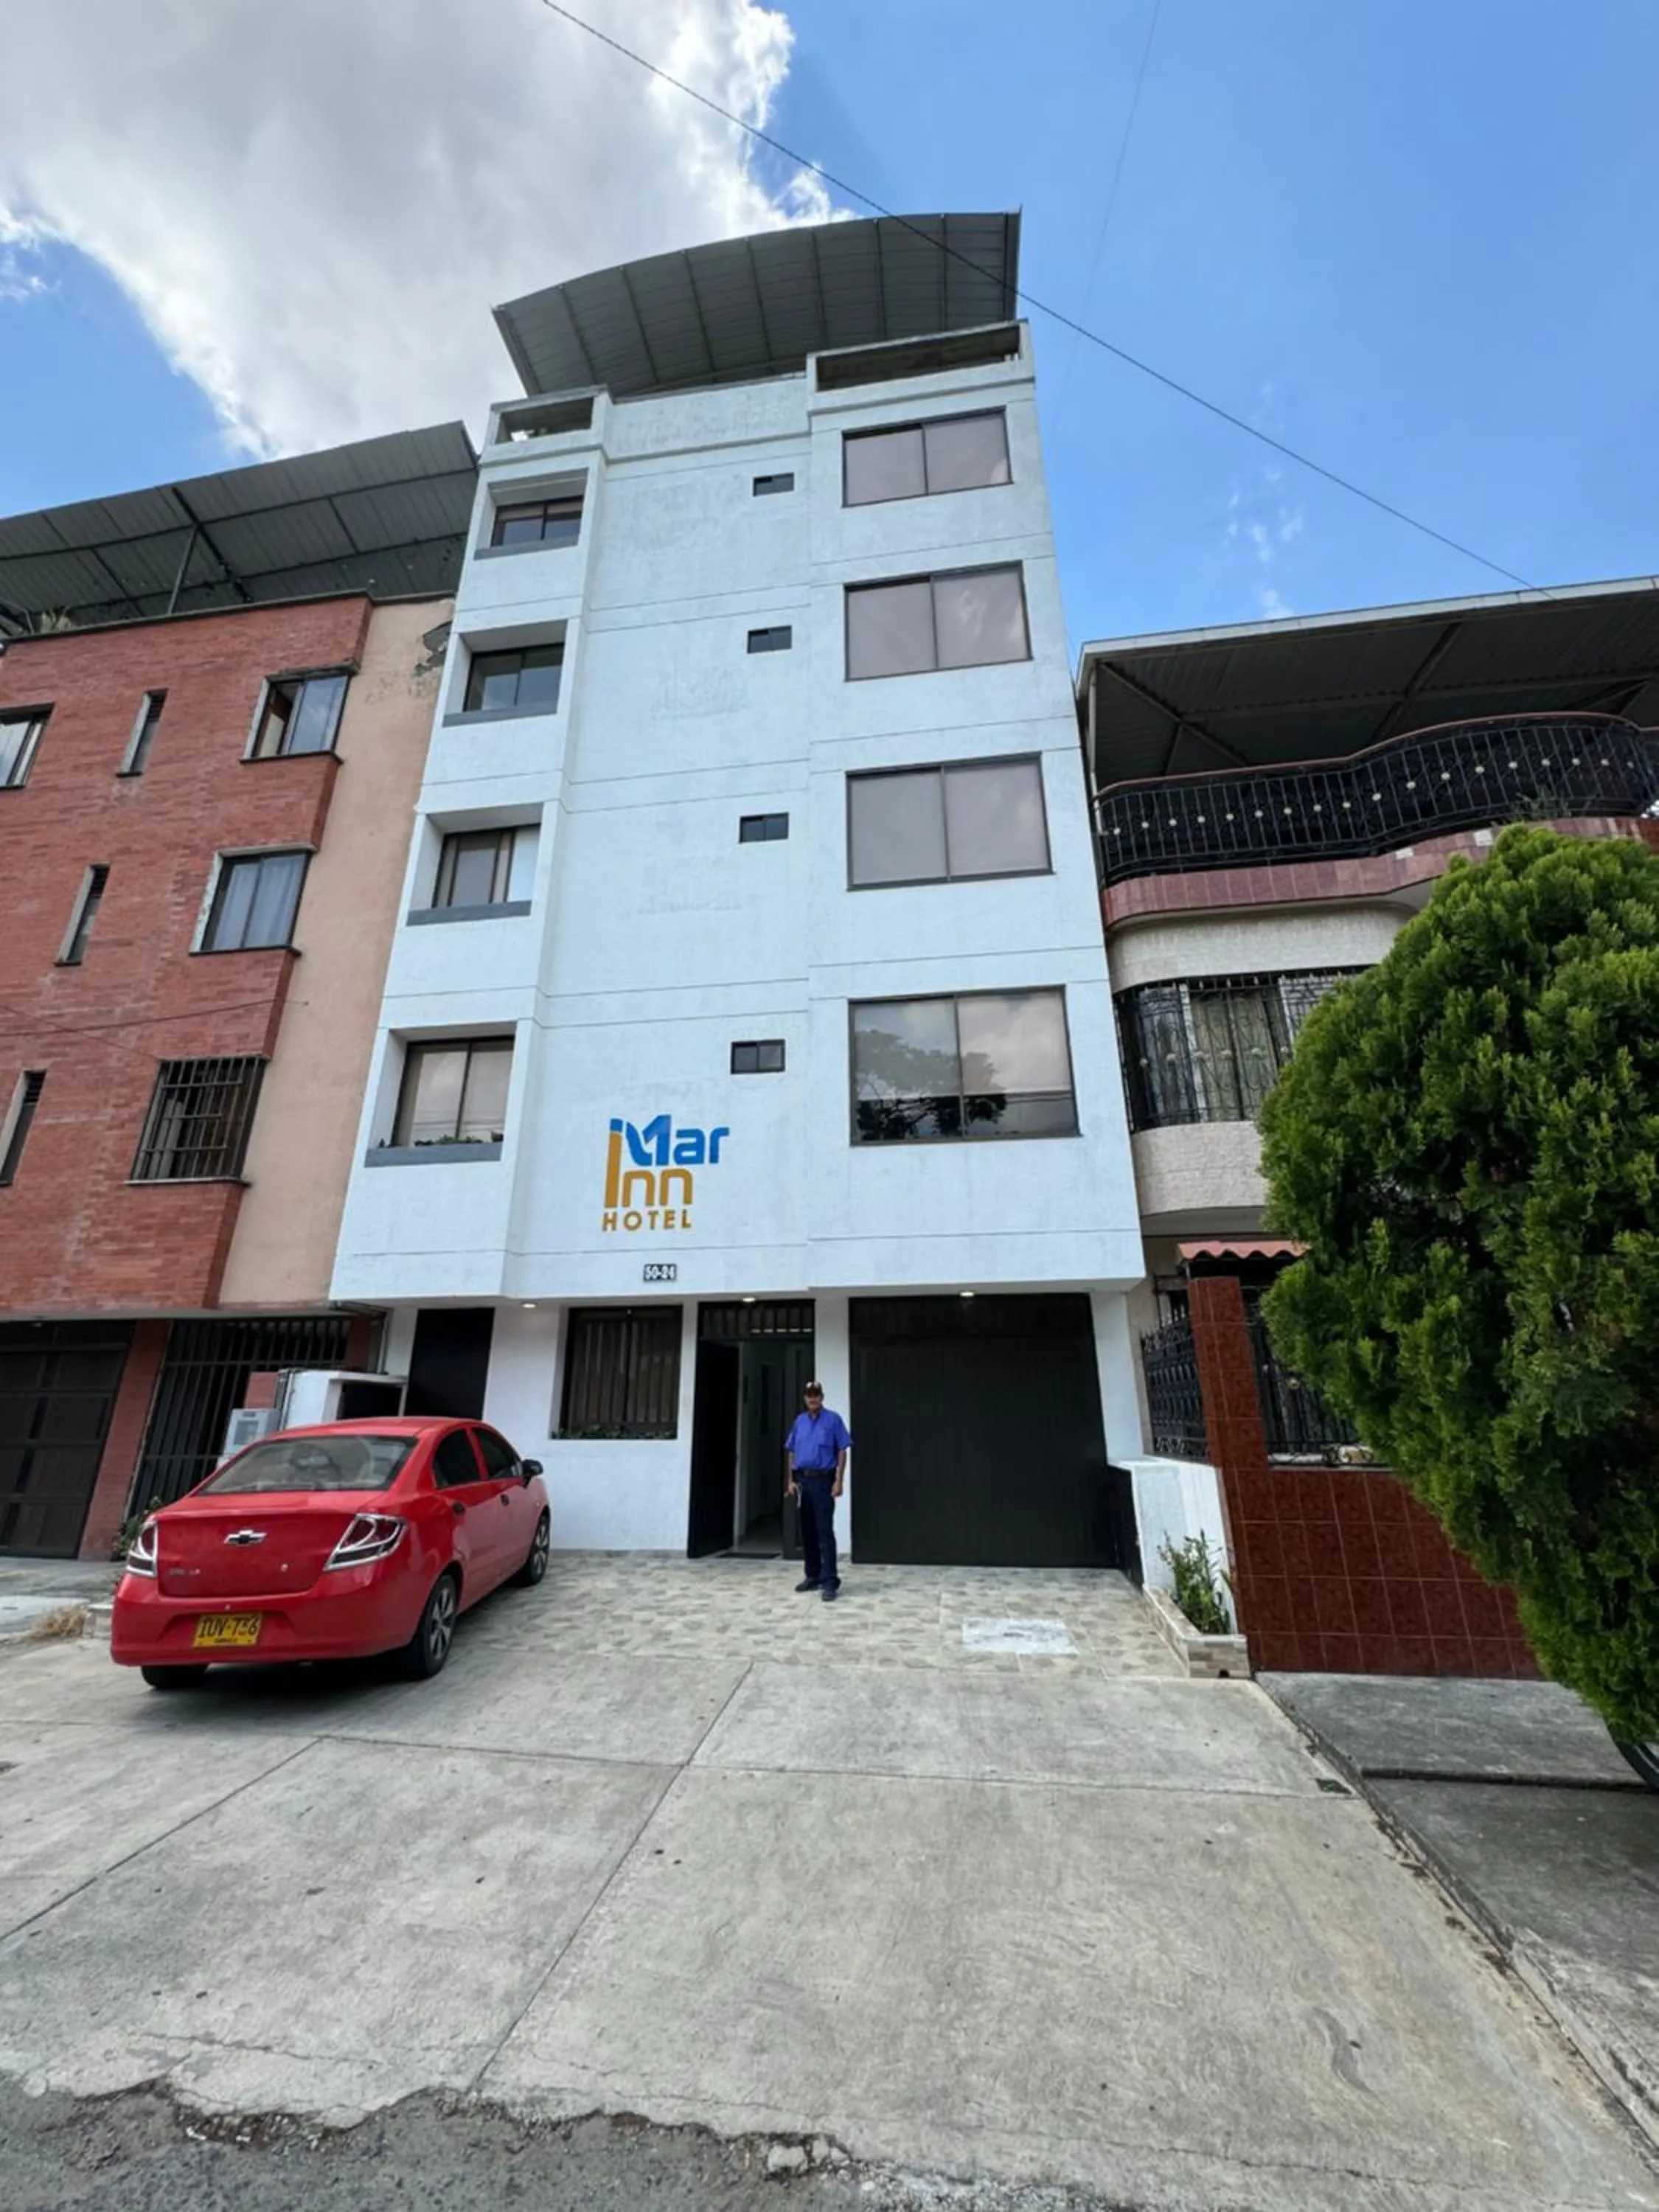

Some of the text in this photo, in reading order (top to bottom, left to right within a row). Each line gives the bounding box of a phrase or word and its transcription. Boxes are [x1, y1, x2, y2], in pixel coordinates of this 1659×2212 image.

[604, 1118, 693, 1208] Inn
[602, 1209, 692, 1231] HOTEL
[645, 1265, 675, 1280] 50-24
